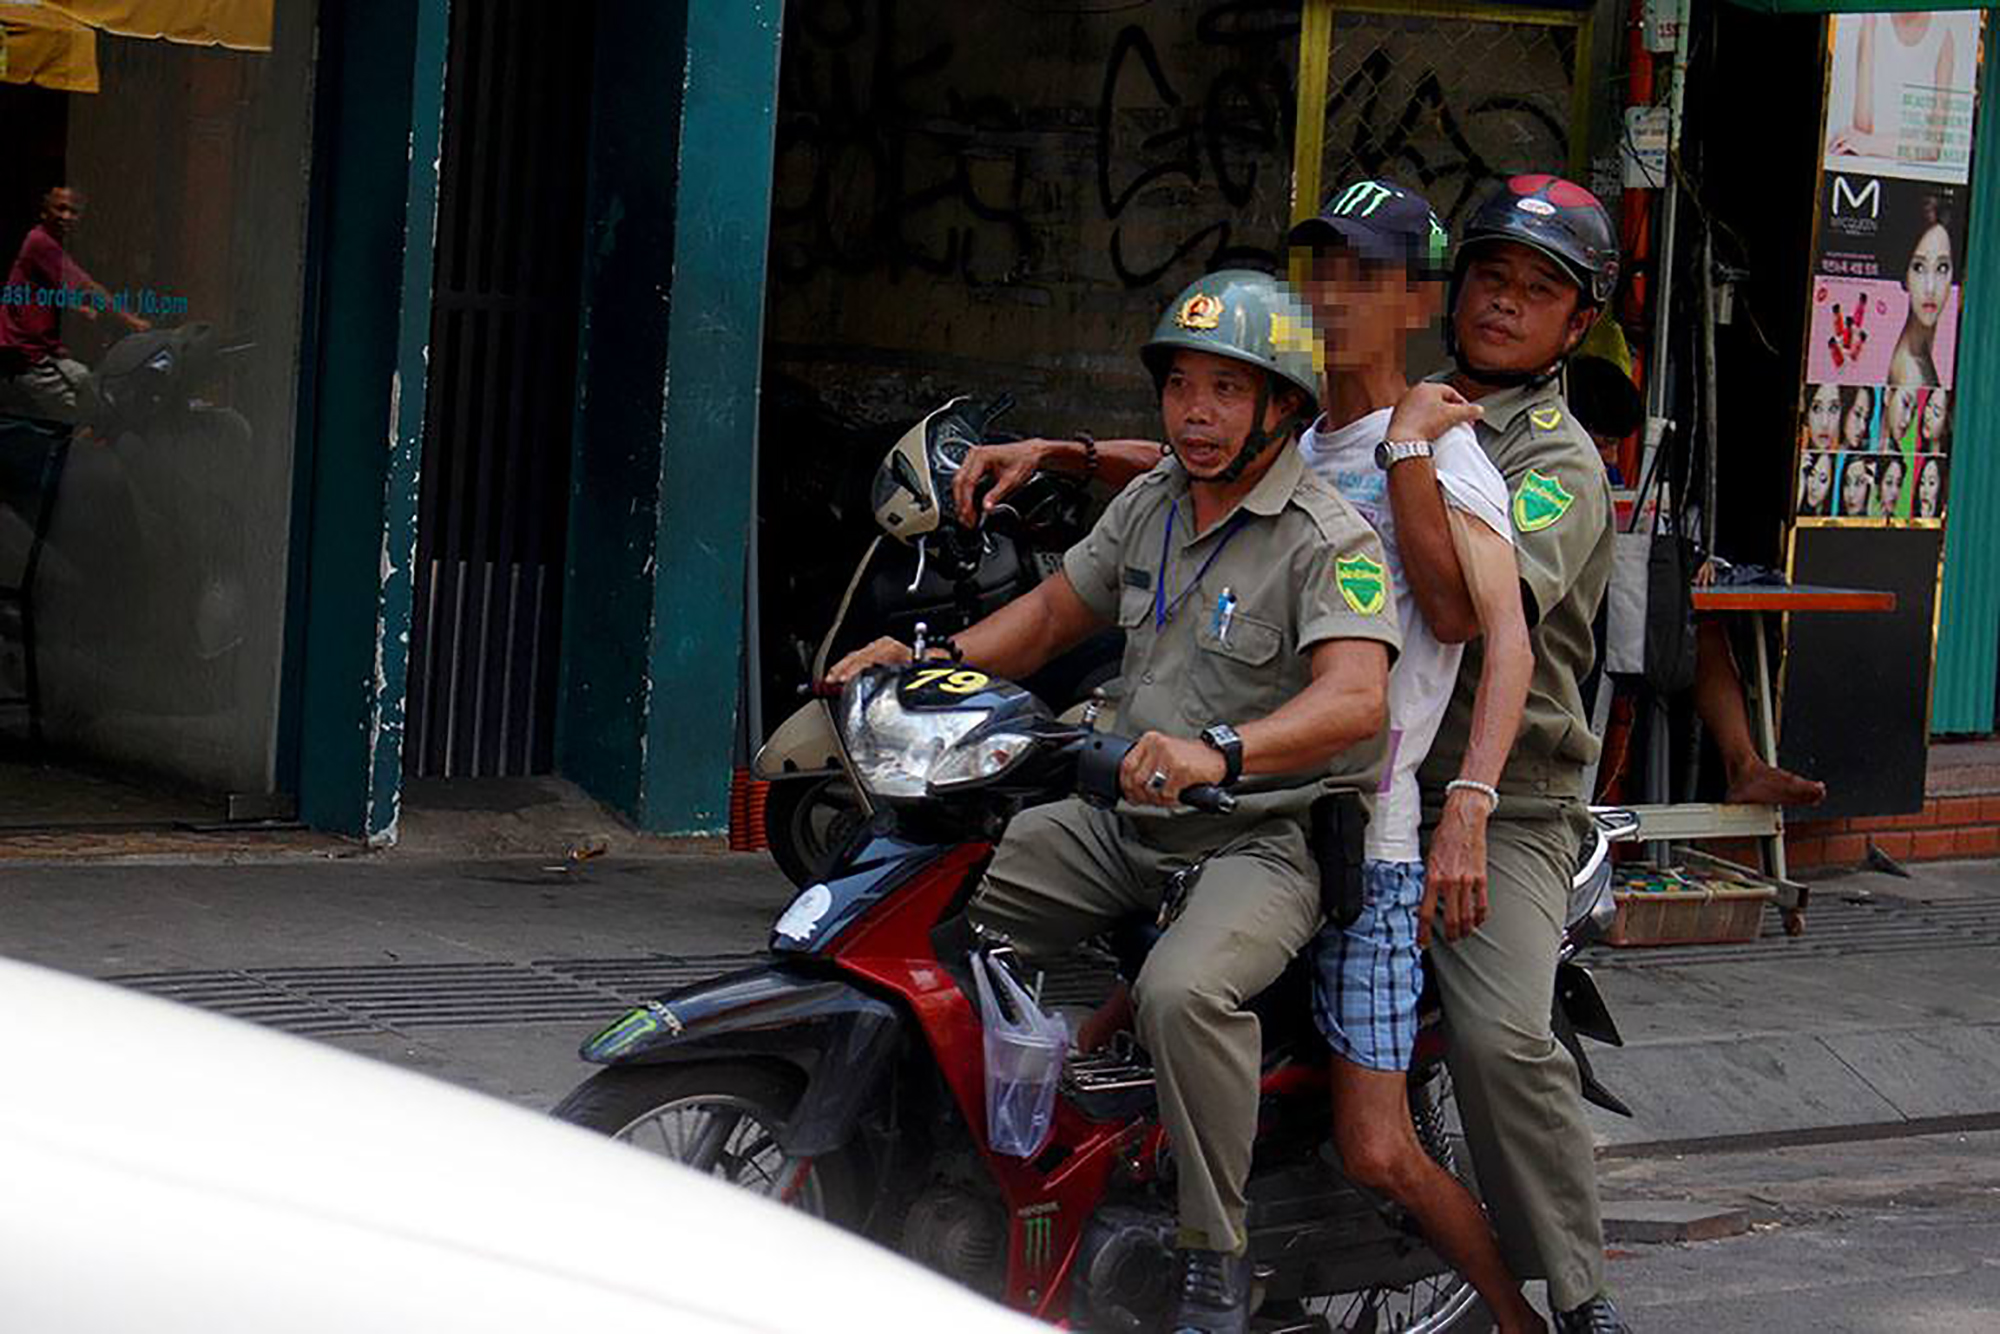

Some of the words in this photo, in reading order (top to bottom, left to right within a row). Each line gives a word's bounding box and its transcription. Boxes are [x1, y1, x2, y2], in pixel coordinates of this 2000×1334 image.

[1832, 177, 1880, 218] M
[0, 284, 31, 305] ast
[904, 668, 989, 694] 79
